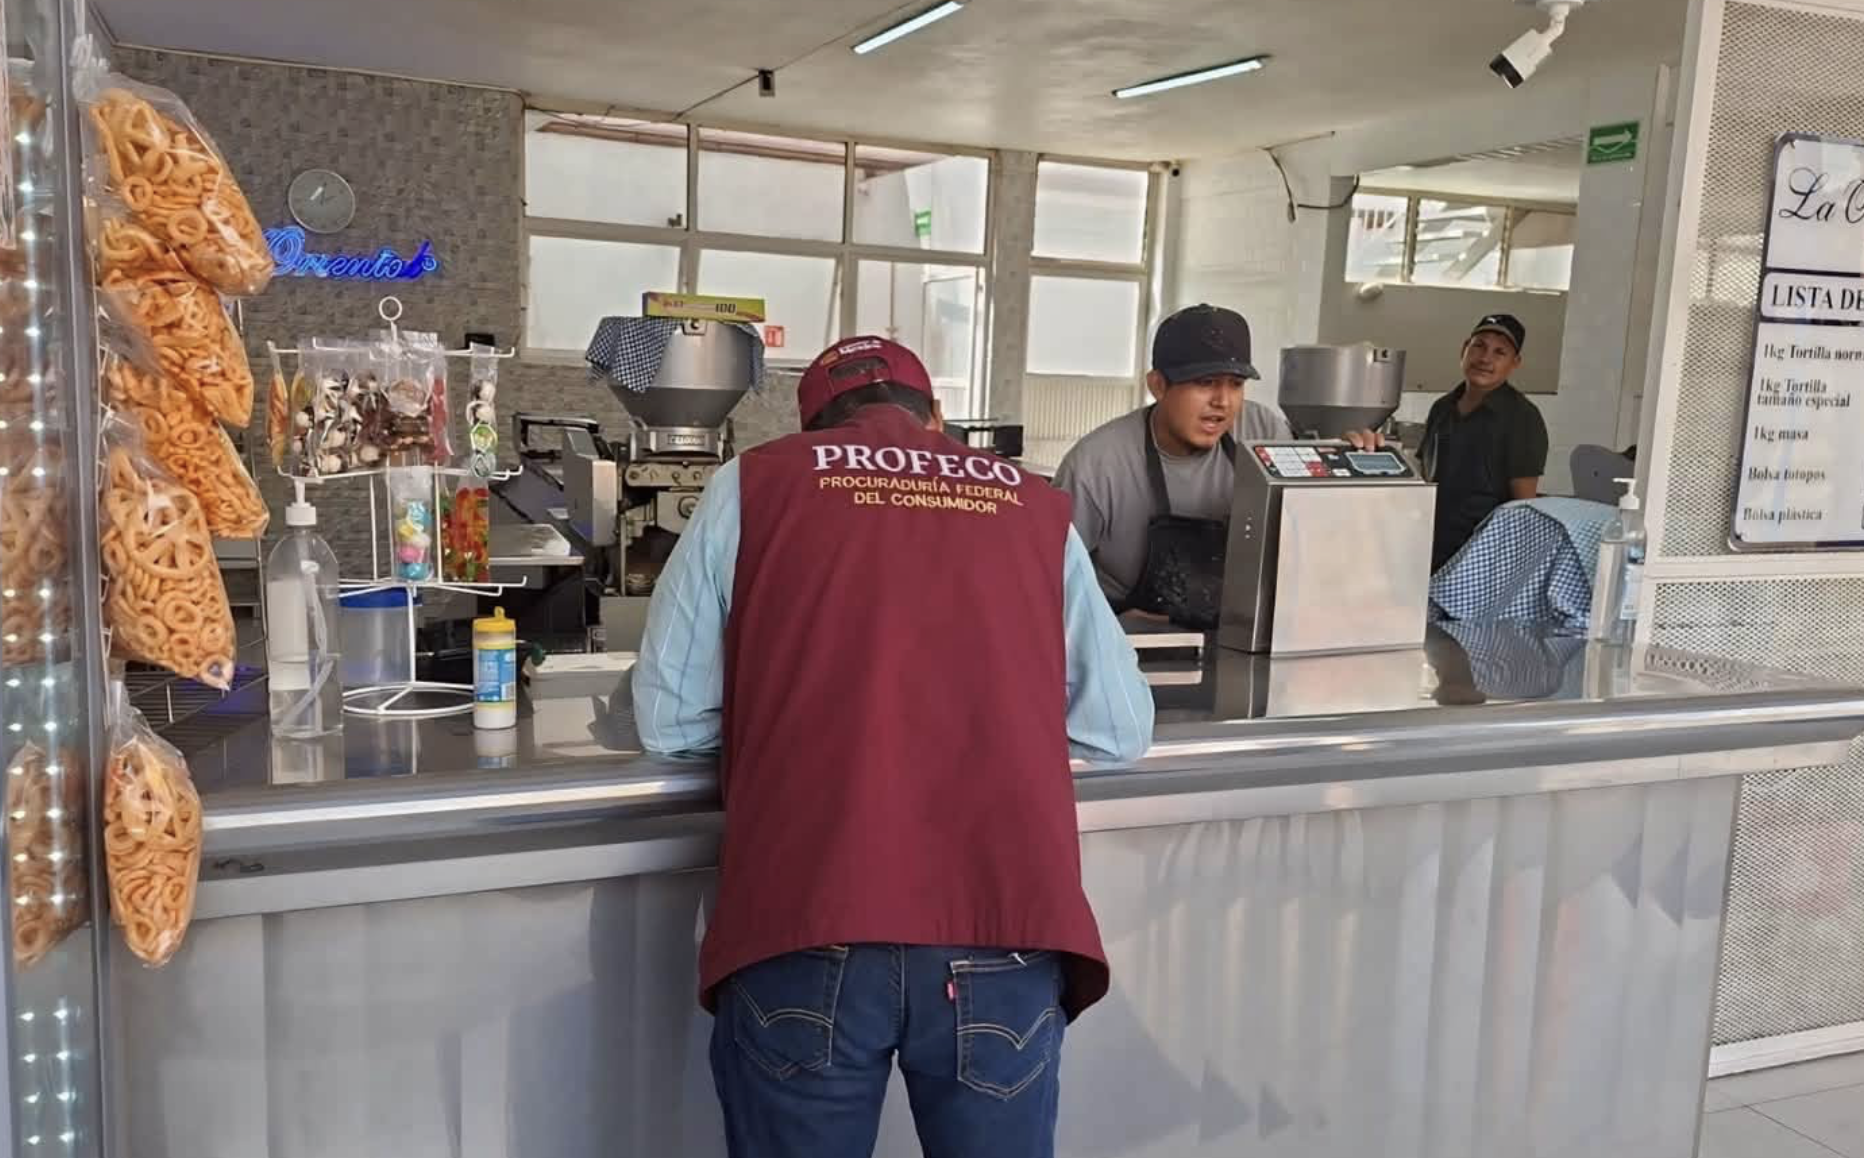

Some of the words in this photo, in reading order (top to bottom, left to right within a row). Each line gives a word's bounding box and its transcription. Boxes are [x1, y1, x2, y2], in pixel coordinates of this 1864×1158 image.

[1778, 167, 1837, 222] La
[1771, 284, 1833, 309] LISTA
[1790, 345, 1831, 359] Tortilla
[1785, 378, 1827, 393] Tortilla
[1805, 393, 1849, 410] especial
[1778, 430, 1808, 440] masa
[812, 444, 1022, 487] PROFECO
[1748, 467, 1780, 480] Bolsa
[820, 476, 950, 494] PROCURADURÍA
[956, 484, 1024, 506] FEDERAL
[854, 491, 885, 505] DEL
[891, 492, 997, 514] CONSUMIDOR
[1743, 508, 1775, 520] Bolsa
